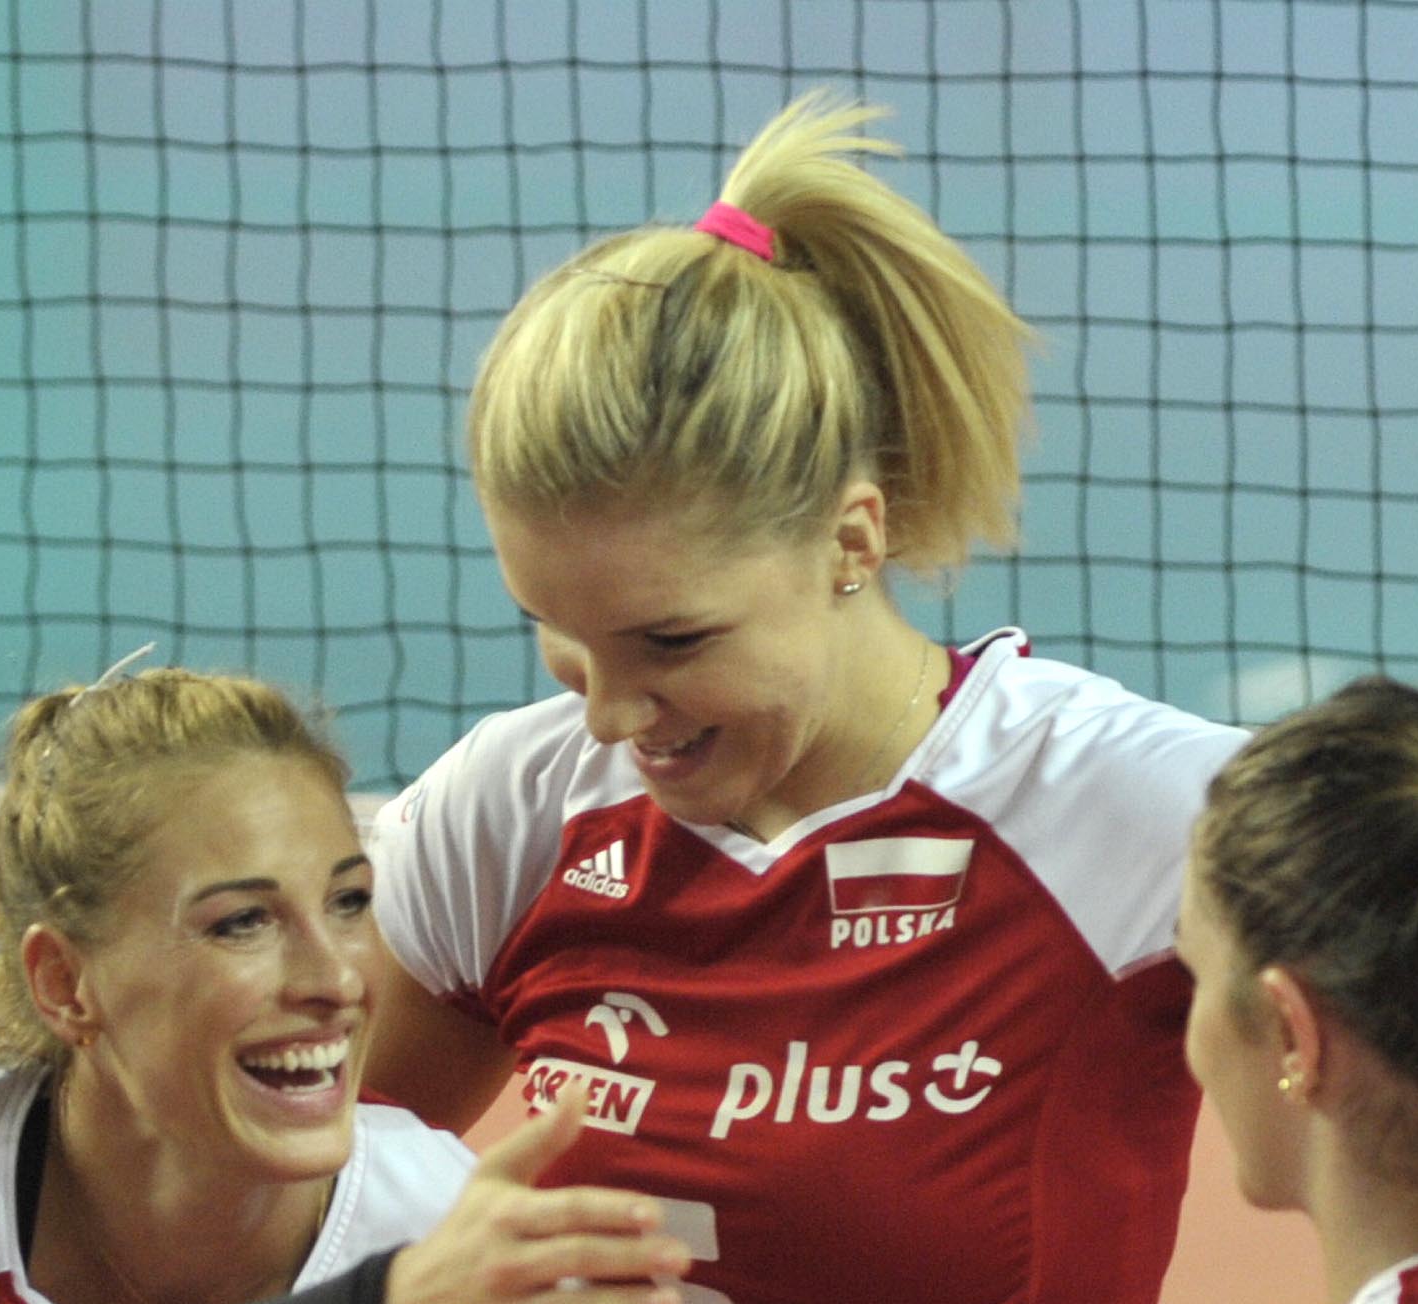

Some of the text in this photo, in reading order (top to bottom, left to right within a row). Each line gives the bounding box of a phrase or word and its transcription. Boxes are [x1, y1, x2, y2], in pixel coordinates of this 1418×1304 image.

[562, 867, 629, 899] adidas
[830, 906, 956, 949] POLSKA
[709, 1040, 912, 1140] plus
